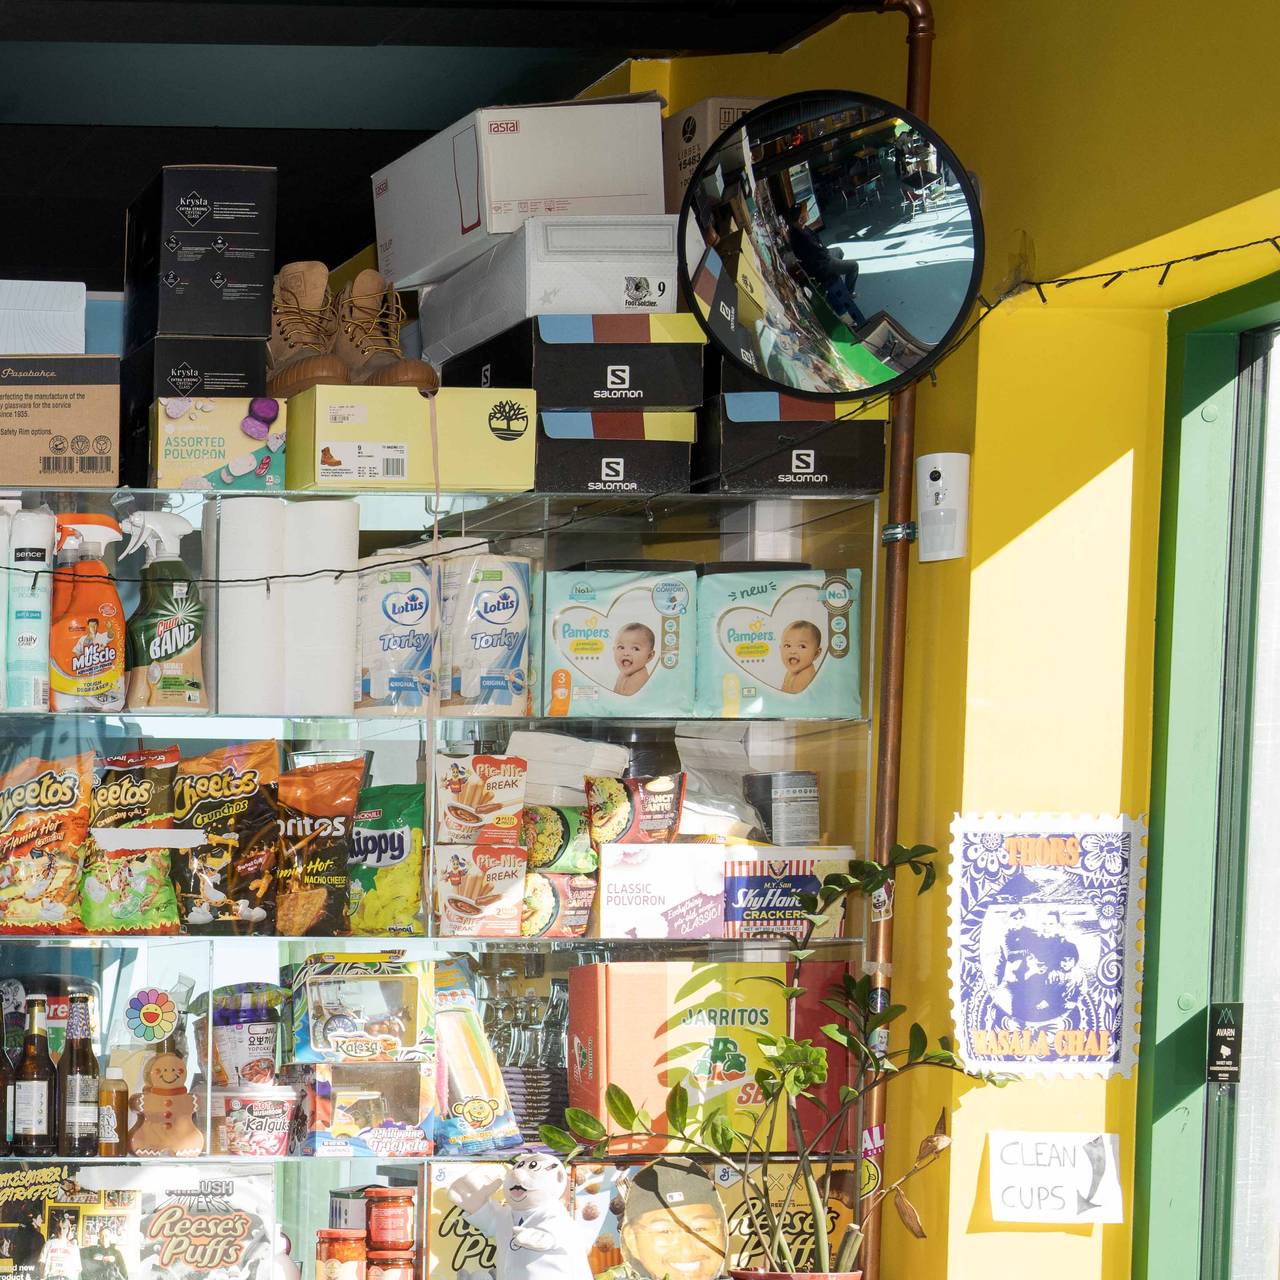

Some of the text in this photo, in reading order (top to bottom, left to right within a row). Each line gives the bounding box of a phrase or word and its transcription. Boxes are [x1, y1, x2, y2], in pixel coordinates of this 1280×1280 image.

[489, 120, 520, 134] rastal
[180, 197, 208, 206] Krysta
[657, 282, 666, 297] 9
[171, 368, 199, 378] Krysta
[4, 402, 32, 410] glassware
[0, 428, 17, 437] Safety
[31, 428, 52, 437] options.
[164, 436, 226, 448] ASSORTED
[15, 549, 44, 560] sence
[739, 583, 770, 599] new
[391, 601, 424, 615] Lotus
[482, 600, 516, 614] Lotus
[17, 633, 38, 645] daily
[562, 623, 609, 640] Pampers
[727, 628, 775, 643] Pampers
[149, 623, 196, 659] BANG
[379, 629, 431, 651] Torky
[471, 628, 519, 651] Torky
[72, 649, 116, 670] Muscle
[390, 680, 415, 688] ORIGINAL
[557, 672, 566, 684] 3
[475, 762, 524, 780] Pic-Nic
[486, 779, 519, 791] BREAK
[172, 770, 258, 819] Cheetos
[193, 800, 249, 828] Crunchos
[40, 819, 61, 836] Hot
[1005, 837, 1081, 868] THORS
[476, 852, 524, 870] Pic-Nic
[303, 875, 347, 885] NACHO CHEESE
[486, 869, 519, 882] BREAK
[606, 883, 652, 895] CLASSIC
[606, 895, 666, 906] POLVORON
[681, 1008, 770, 1027] JARRITOS
[1215, 1028, 1236, 1037] AVARN
[1055, 1029, 1110, 1057] CHAI
[372, 1128, 424, 1141] Philippine
[369, 1137, 428, 1152] Tricycle
[999, 1141, 1076, 1170] CLEAN
[1001, 1183, 1067, 1213] CUPS
[148, 1205, 251, 1241] Reese's
[162, 1236, 243, 1270] Puffs
[18, 1264, 35, 1272] new
